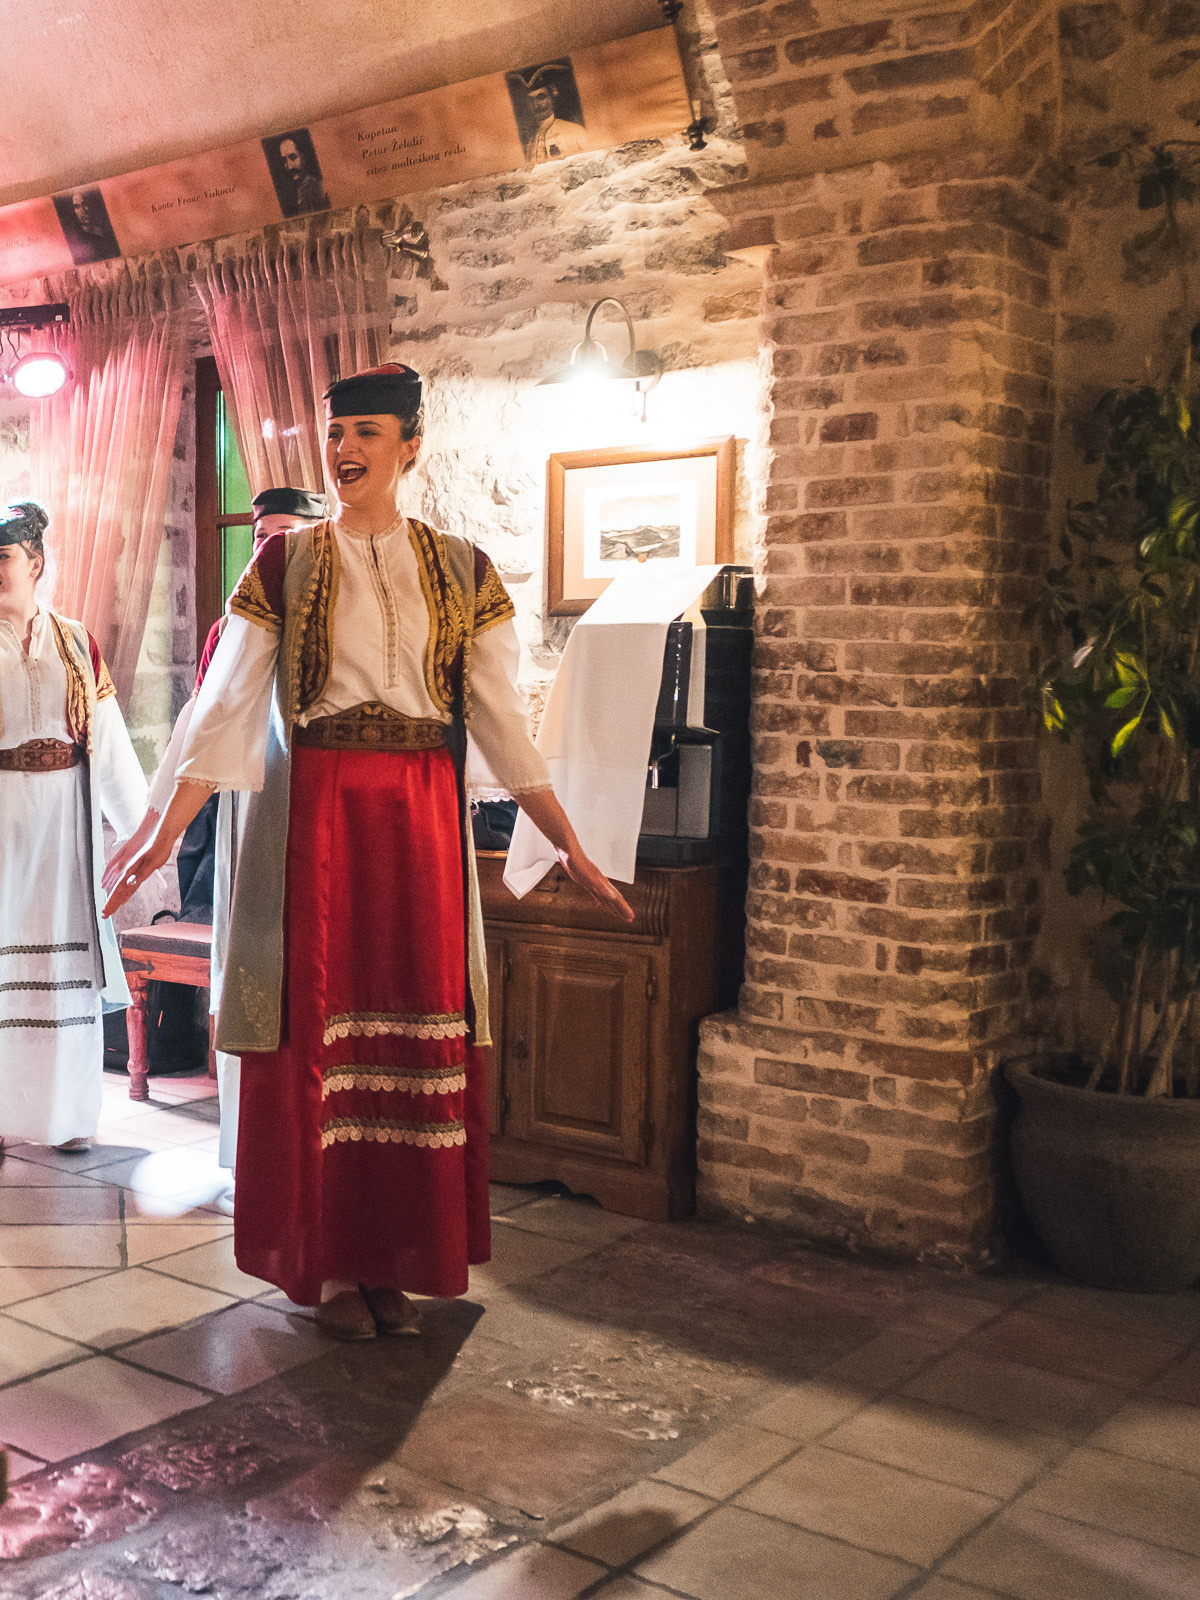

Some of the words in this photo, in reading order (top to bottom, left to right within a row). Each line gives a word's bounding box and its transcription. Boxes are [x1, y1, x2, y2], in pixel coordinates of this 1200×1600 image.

[357, 126, 397, 141] Kapetan
[362, 147, 387, 159] Petar
[444, 144, 466, 157] reda
[151, 202, 174, 213] Konte
